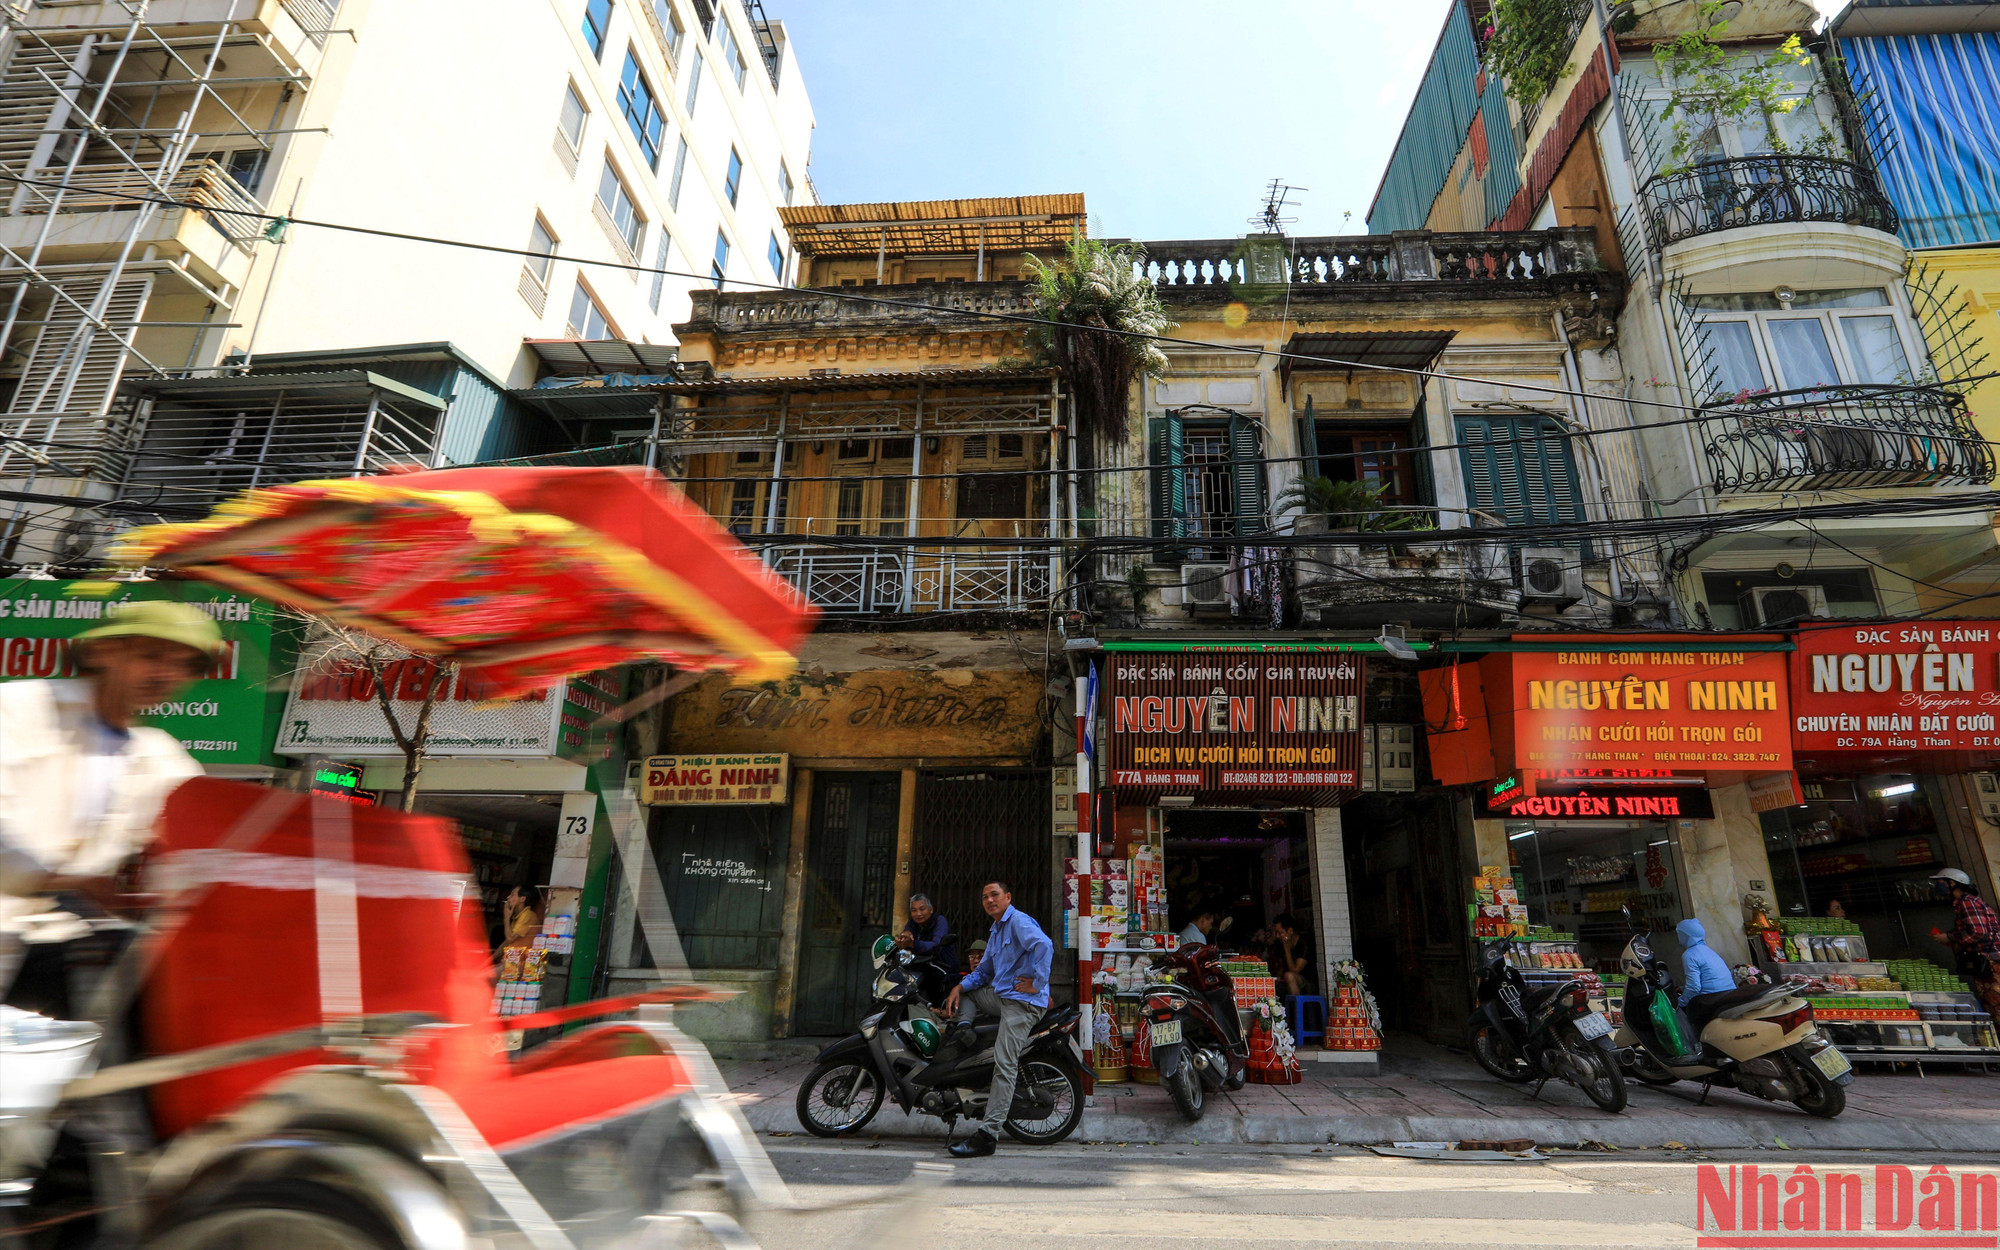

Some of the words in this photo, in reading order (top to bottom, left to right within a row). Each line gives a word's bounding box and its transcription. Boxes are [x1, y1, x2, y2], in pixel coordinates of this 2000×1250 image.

[13, 593, 52, 618] SẢN
[54, 596, 102, 619] BÁNH
[1899, 626, 1934, 643] SẢN
[1941, 626, 1990, 643] BÁNH
[1700, 652, 1744, 665] THAN
[1810, 643, 1975, 693] NGUYÊN
[1117, 664, 1146, 684] ĐẶC
[1183, 664, 1222, 681] BÁNH
[1266, 667, 1294, 680] GIA
[1299, 661, 1356, 681] TRUYỀN
[1529, 674, 1671, 711] NGUYÊN
[1688, 680, 1778, 711] NINH
[1899, 692, 1973, 711] Nguyên
[186, 698, 219, 717] GÓI
[1114, 686, 1255, 734] NGUYÊN
[1270, 695, 1358, 733] NINH
[291, 720, 309, 743] 73
[1542, 723, 1592, 745] NHẬN
[1599, 721, 1641, 742] CƯỚI
[1646, 720, 1675, 742] HỎI
[1680, 726, 1727, 746] TRỌN
[1733, 722, 1763, 743] GÓI
[1797, 713, 1861, 732] CHUYÊN
[1867, 712, 1913, 736] NHẬN
[1919, 712, 1950, 735] ĐẶT
[1956, 711, 1995, 732] CƯỚI
[1836, 738, 1858, 747] ĐC.
[1861, 738, 1882, 747] 79A
[1887, 735, 1918, 749] Hàng
[1922, 736, 1951, 747] Than
[716, 756, 750, 766] BÁNH
[754, 755, 782, 765] CỐM
[1134, 747, 1171, 766] DỊCH
[1175, 747, 1195, 767] VỤ
[1198, 742, 1234, 764] CƯỚI
[1238, 741, 1263, 763] HỎI
[1267, 747, 1307, 767] TRỌN
[1311, 744, 1336, 763] GÓI
[1585, 750, 1611, 761] HÀNG
[1614, 752, 1639, 761] THAN
[1654, 751, 1676, 763] ĐIỆN
[720, 768, 779, 785] NINH
[1117, 771, 1142, 784] 77A
[1145, 772, 1171, 784] HÀNG
[1174, 774, 1200, 784] THAN
[1259, 772, 1274, 784] 828
[1324, 773, 1338, 784] 600
[1339, 773, 1353, 784] 122
[1510, 791, 1610, 816] NGUYÊN
[1616, 797, 1680, 815] NINH
[566, 816, 587, 834] 73
[917, 1032, 931, 1047] Grab
